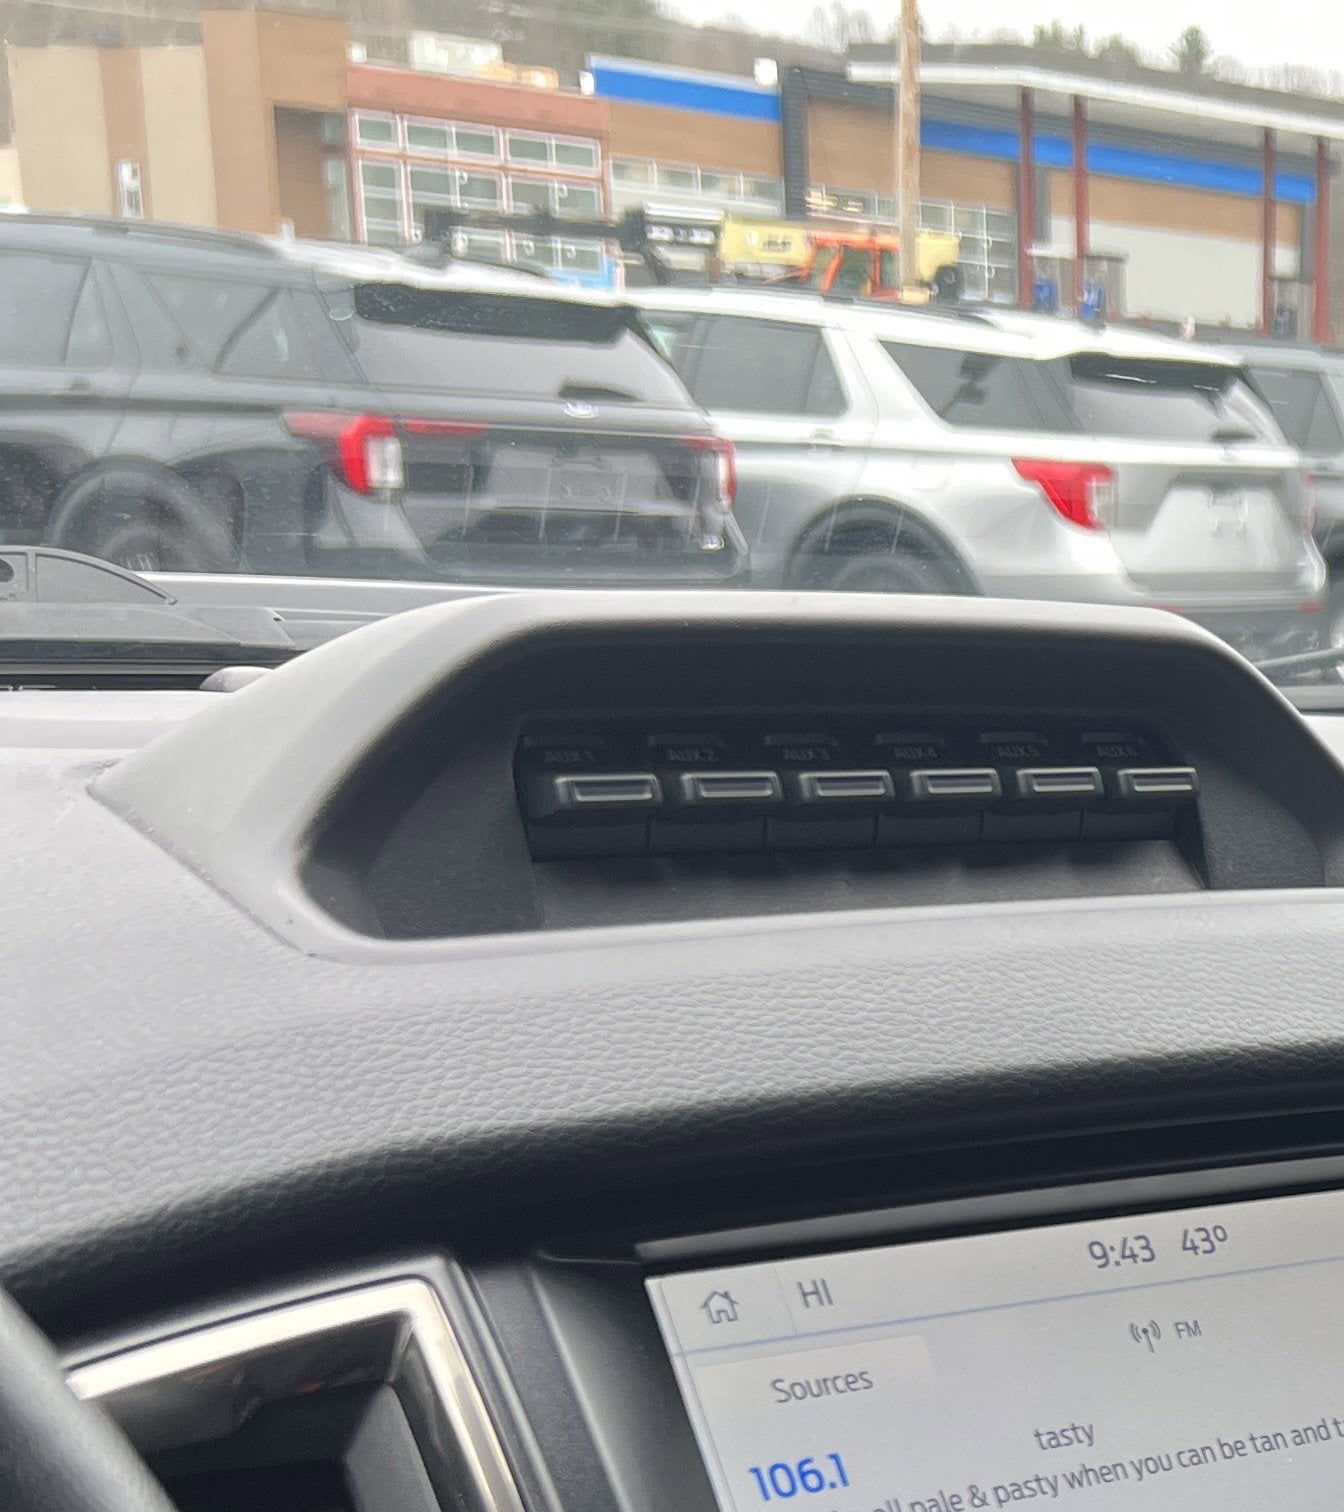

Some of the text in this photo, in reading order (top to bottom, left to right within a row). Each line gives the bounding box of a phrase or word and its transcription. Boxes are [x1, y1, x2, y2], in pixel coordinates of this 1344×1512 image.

[1088, 1234, 1156, 1268] 9:43
[797, 1279, 833, 1309] HI
[1174, 1321, 1202, 1340] FM
[771, 1368, 875, 1404] Sources
[1033, 1422, 1095, 1451] tasty
[749, 1452, 850, 1501] 106.1
[968, 1484, 991, 1510] &
[992, 1473, 1060, 1510] pasty
[1062, 1461, 1129, 1491] when
[1130, 1451, 1173, 1483] you
[1176, 1444, 1217, 1469] can
[1217, 1437, 1249, 1461] be
[1249, 1430, 1288, 1455] tan
[1291, 1419, 1332, 1447] and
